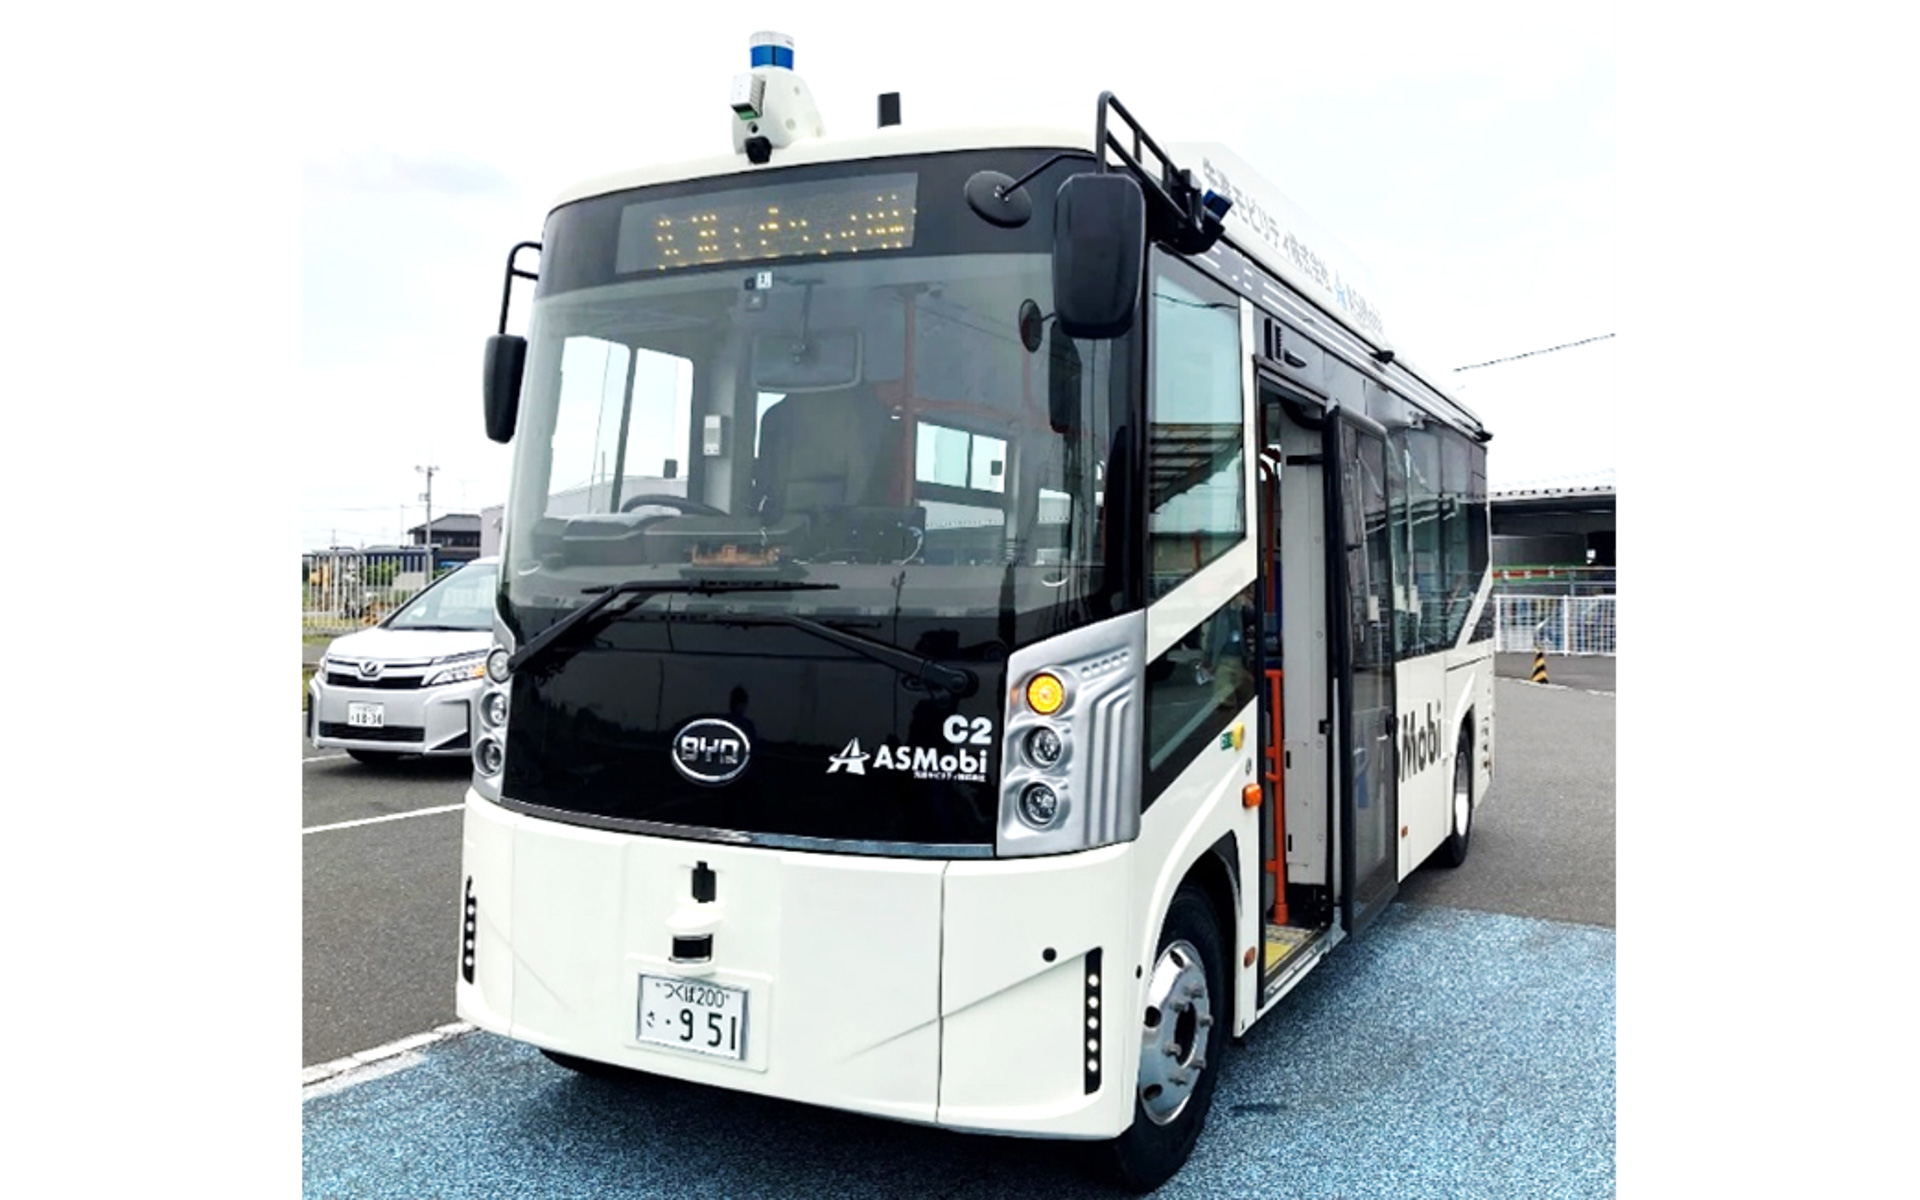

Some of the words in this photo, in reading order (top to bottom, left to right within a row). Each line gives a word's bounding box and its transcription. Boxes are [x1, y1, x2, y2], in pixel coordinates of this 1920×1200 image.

[943, 714, 992, 745] C2
[681, 735, 739, 764] BYD
[873, 744, 987, 774] ASMobi
